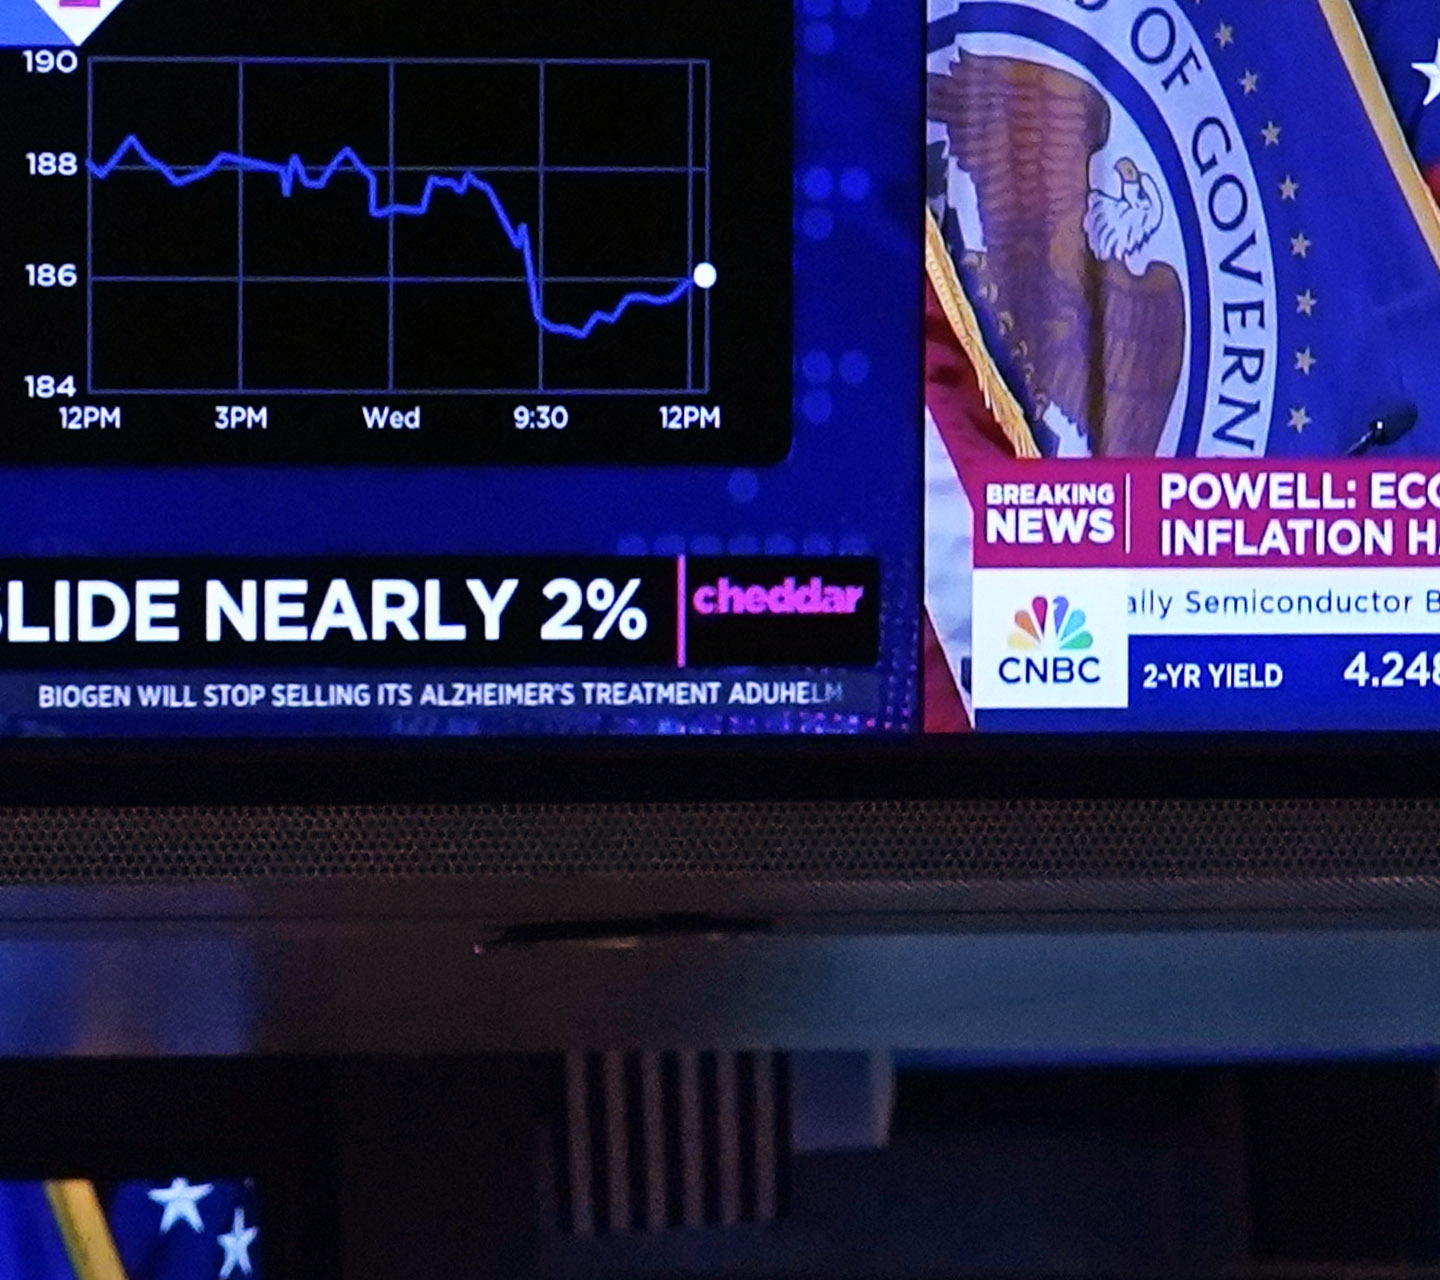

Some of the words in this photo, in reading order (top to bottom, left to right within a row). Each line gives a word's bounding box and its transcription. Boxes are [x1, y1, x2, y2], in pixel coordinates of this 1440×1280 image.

[22, 51, 79, 74] 190
[24, 264, 78, 288] 186
[361, 404, 422, 432] Wed
[512, 404, 569, 432] 9:30
[1160, 472, 1356, 510] POWELL:
[205, 577, 519, 642] NEARLY
[539, 577, 648, 642] 2%
[692, 575, 864, 617] cheddar
[1186, 588, 1413, 615] Semiconductor
[998, 656, 1101, 684] CNBC
[38, 684, 131, 709] BIOGEN
[137, 684, 197, 708] WILL
[203, 683, 266, 708] STOP
[270, 682, 371, 707] SELLING
